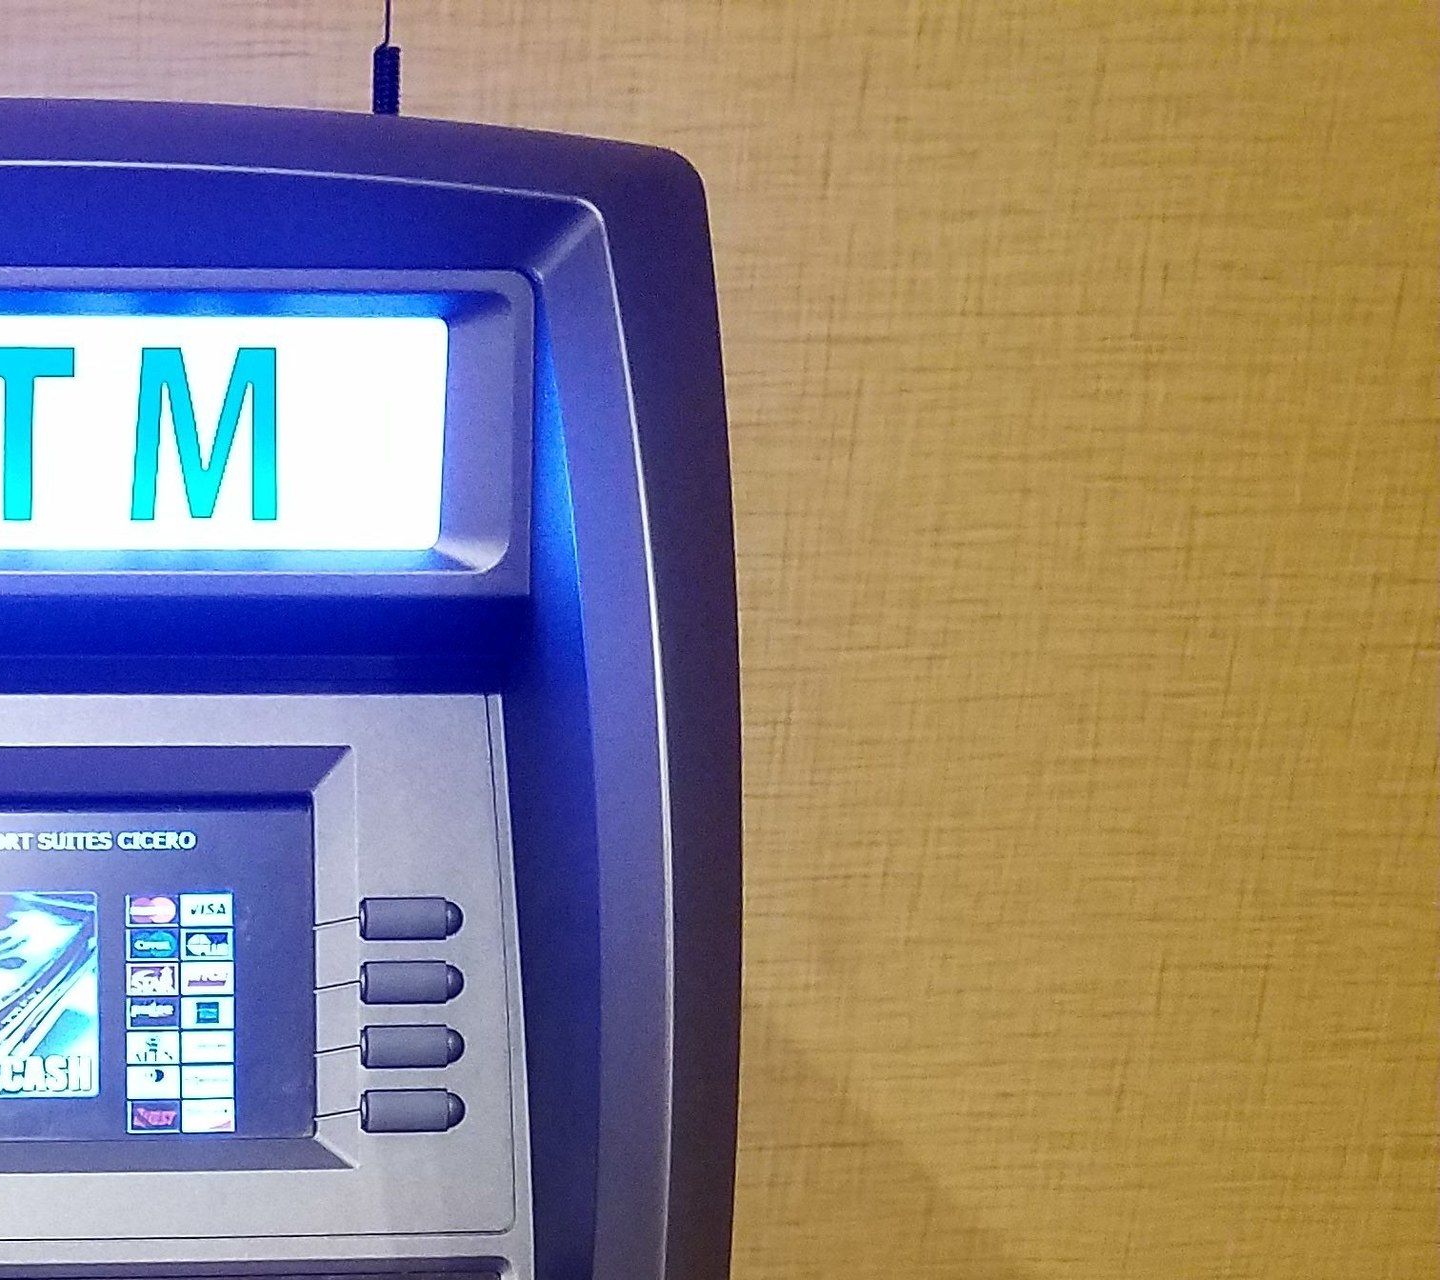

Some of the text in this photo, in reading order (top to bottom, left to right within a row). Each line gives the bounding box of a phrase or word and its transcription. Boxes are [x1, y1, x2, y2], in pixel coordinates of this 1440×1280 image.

[37, 832, 113, 851] SUITES
[116, 831, 198, 850] CICERO
[0, 1055, 92, 1093] CASH
